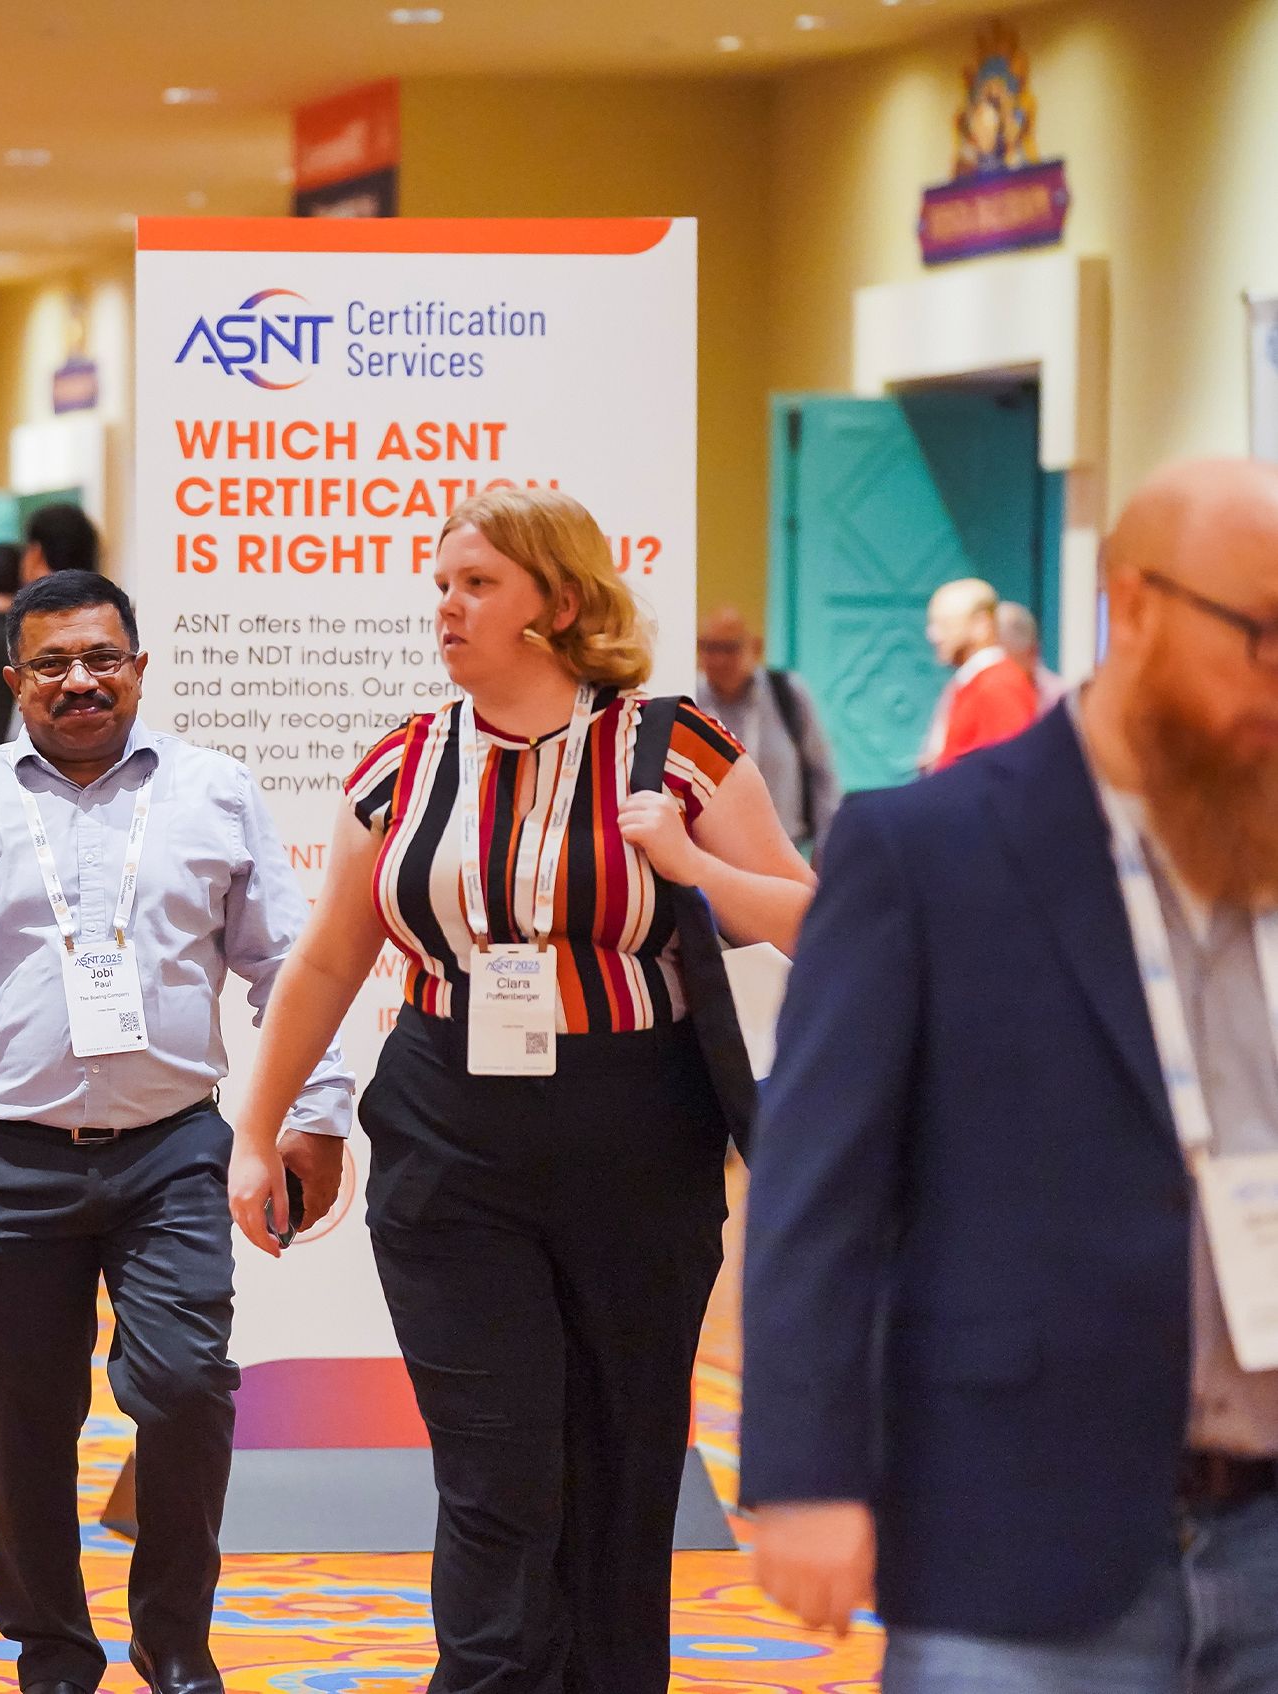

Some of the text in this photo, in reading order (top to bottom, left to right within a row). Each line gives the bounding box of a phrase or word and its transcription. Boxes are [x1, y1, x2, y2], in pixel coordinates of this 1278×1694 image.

[347, 299, 547, 338] Certification
[174, 312, 334, 376] ASNT
[347, 342, 484, 378] Services
[175, 419, 508, 461] WHICH ASNT
[175, 477, 560, 517] CERTIFICAT
[176, 534, 219, 574] IS
[238, 533, 393, 574] RIGHT
[174, 614, 230, 633] ASNT
[239, 614, 301, 633] offers
[309, 614, 346, 633] the
[355, 615, 411, 633] most
[174, 646, 194, 665] in
[202, 646, 239, 665] the
[248, 646, 292, 665] NDT
[301, 646, 393, 669] industry
[402, 647, 423, 665] to
[174, 677, 222, 697] and
[231, 677, 354, 697] ambitions.
[362, 677, 405, 697] Our
[174, 709, 272, 732] globally
[256, 744, 299, 763] you
[308, 740, 344, 760] the
[75, 953, 123, 968] ASNT 2025
[515, 960, 540, 972] 2025
[90, 967, 114, 979] Jobi
[497, 977, 530, 989] Clara
